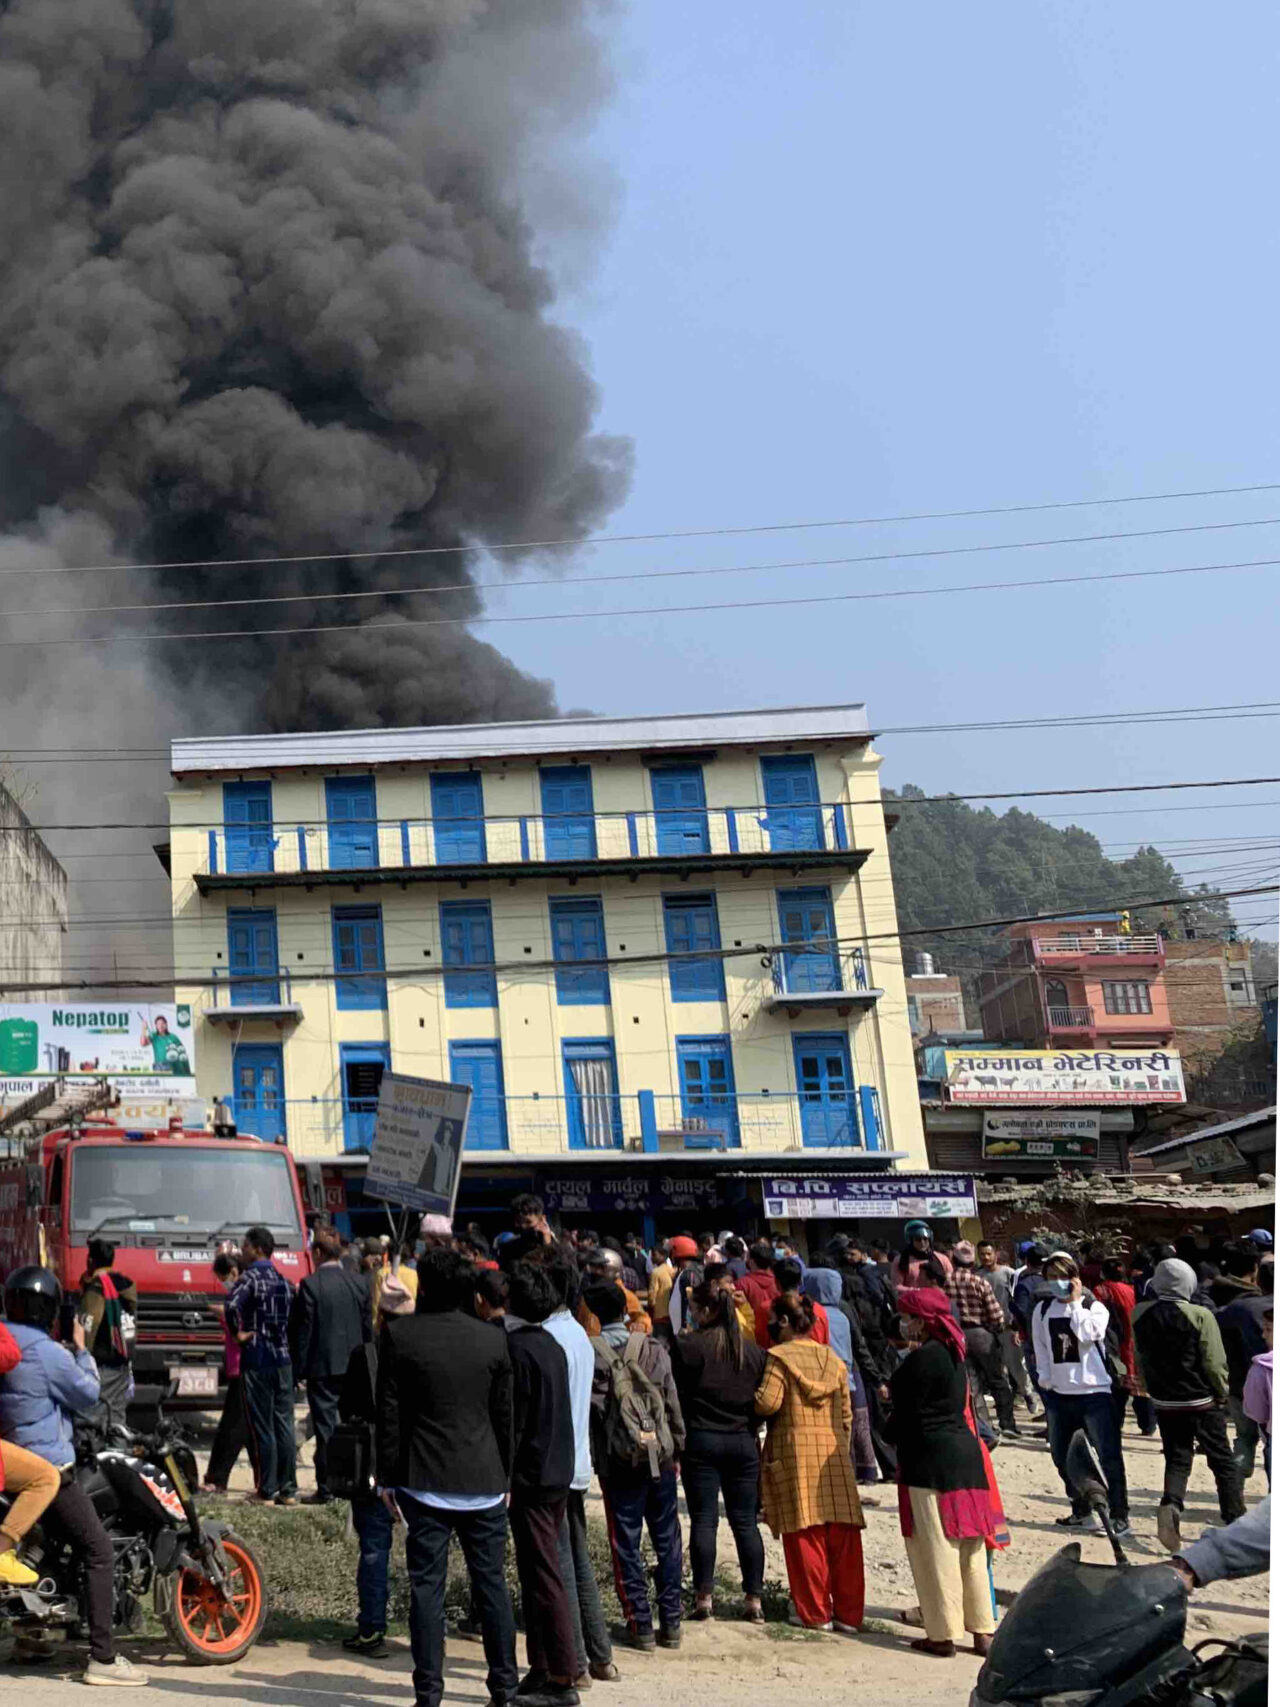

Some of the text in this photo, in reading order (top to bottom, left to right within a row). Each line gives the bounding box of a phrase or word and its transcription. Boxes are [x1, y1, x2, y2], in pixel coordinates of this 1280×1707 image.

[52, 1009, 130, 1028] Nepatop
[954, 1056, 1043, 1072] सम्मान
[846, 1178, 966, 1195] सप्लायर्स
